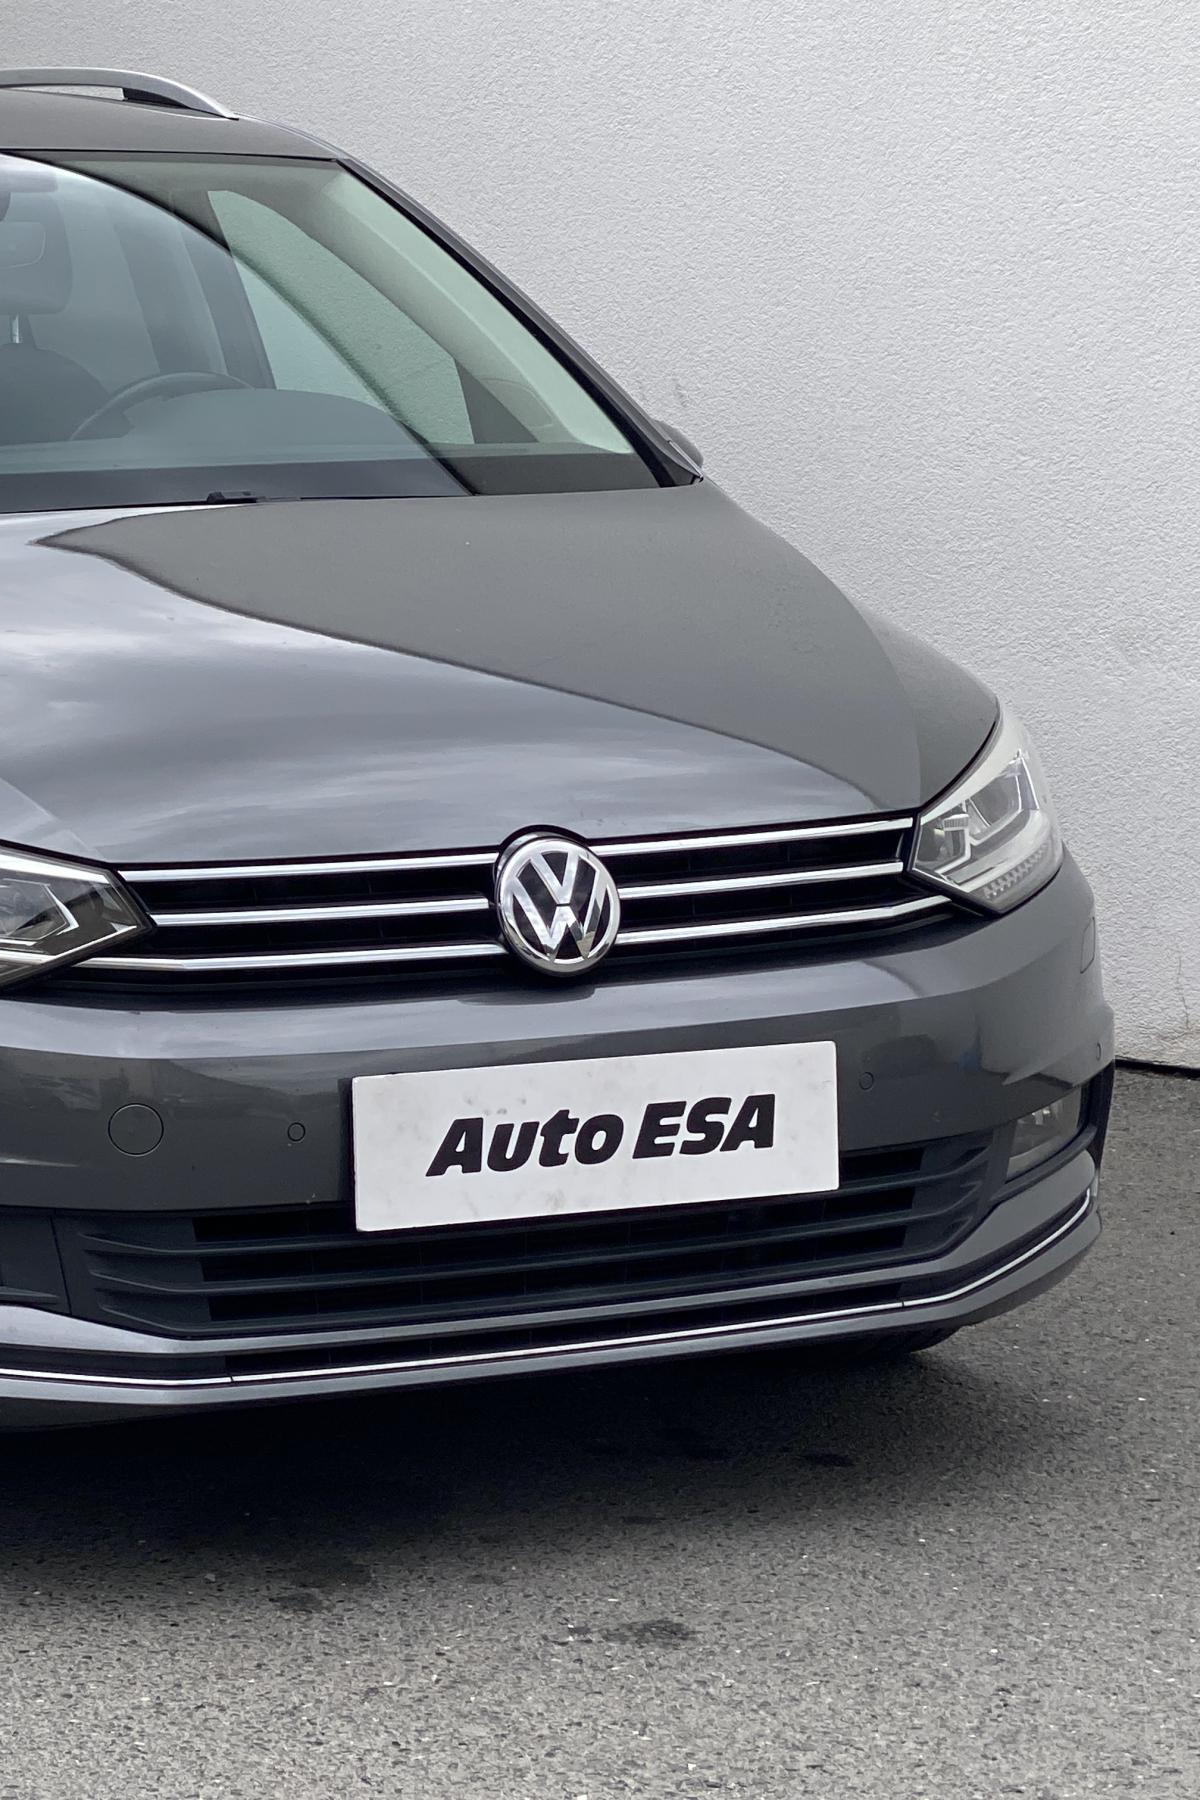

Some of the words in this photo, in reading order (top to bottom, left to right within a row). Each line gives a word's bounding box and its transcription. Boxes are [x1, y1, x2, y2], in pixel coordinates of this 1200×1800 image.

[504, 843, 611, 964] VW
[425, 1109, 624, 1177] Auto
[632, 1093, 776, 1160] ESA
